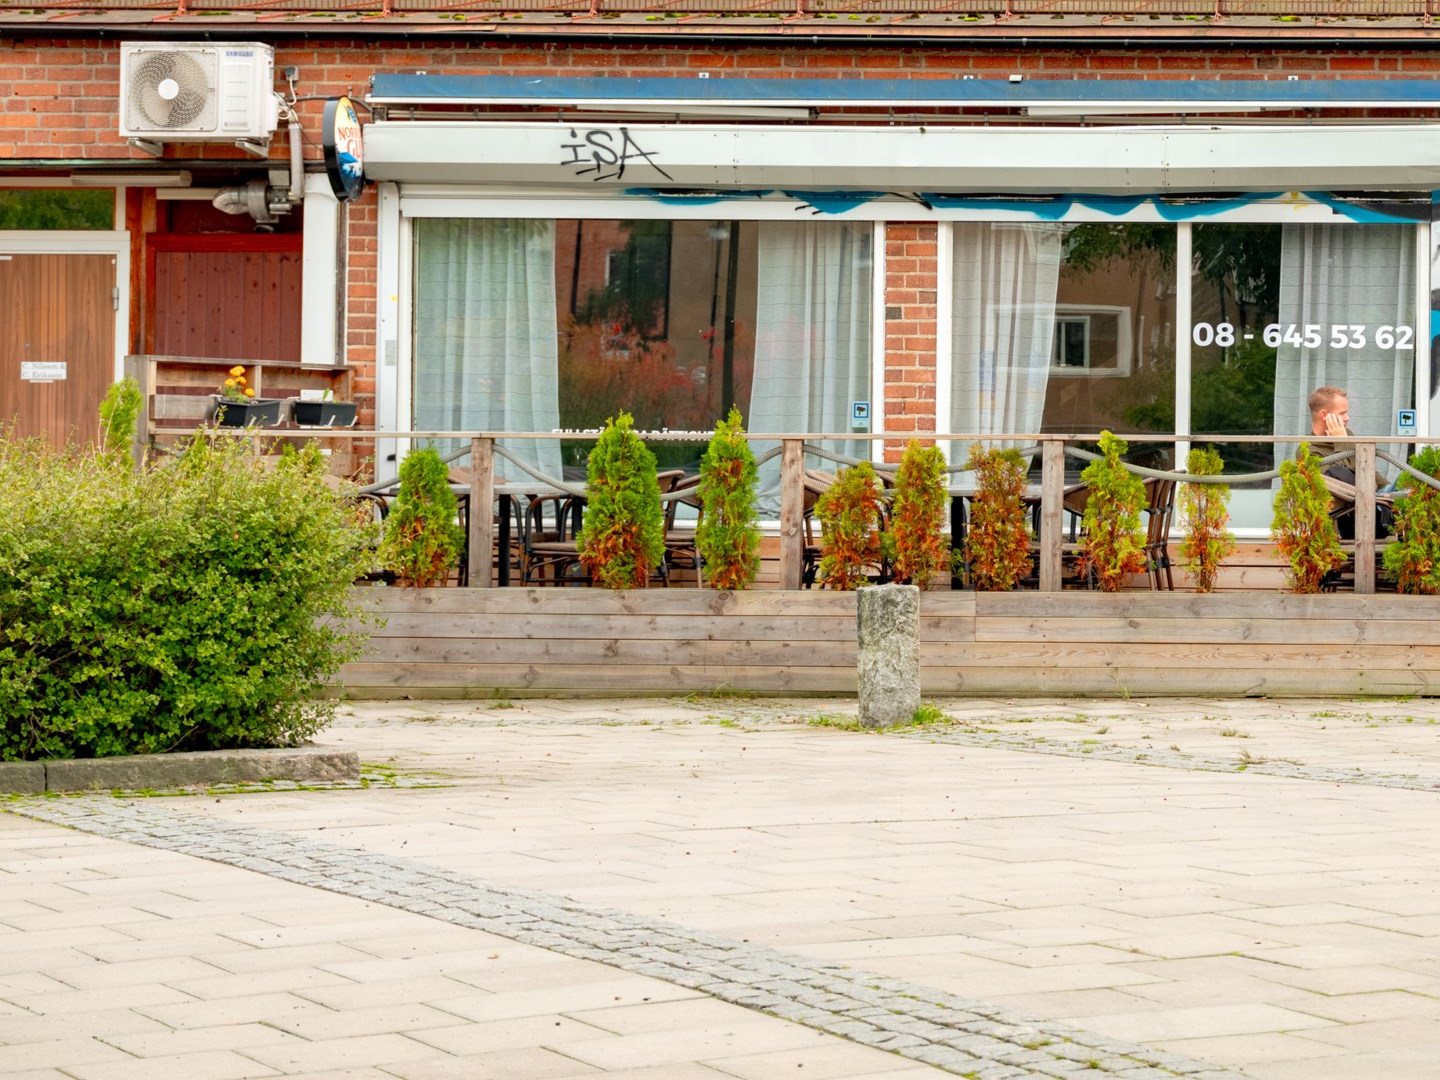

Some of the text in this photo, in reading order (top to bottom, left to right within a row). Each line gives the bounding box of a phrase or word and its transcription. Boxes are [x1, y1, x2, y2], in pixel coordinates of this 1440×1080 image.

[1193, 322, 1235, 347] 08
[1263, 323, 1322, 348] 645
[1330, 324, 1366, 349] 53
[1375, 325, 1414, 350] 62
